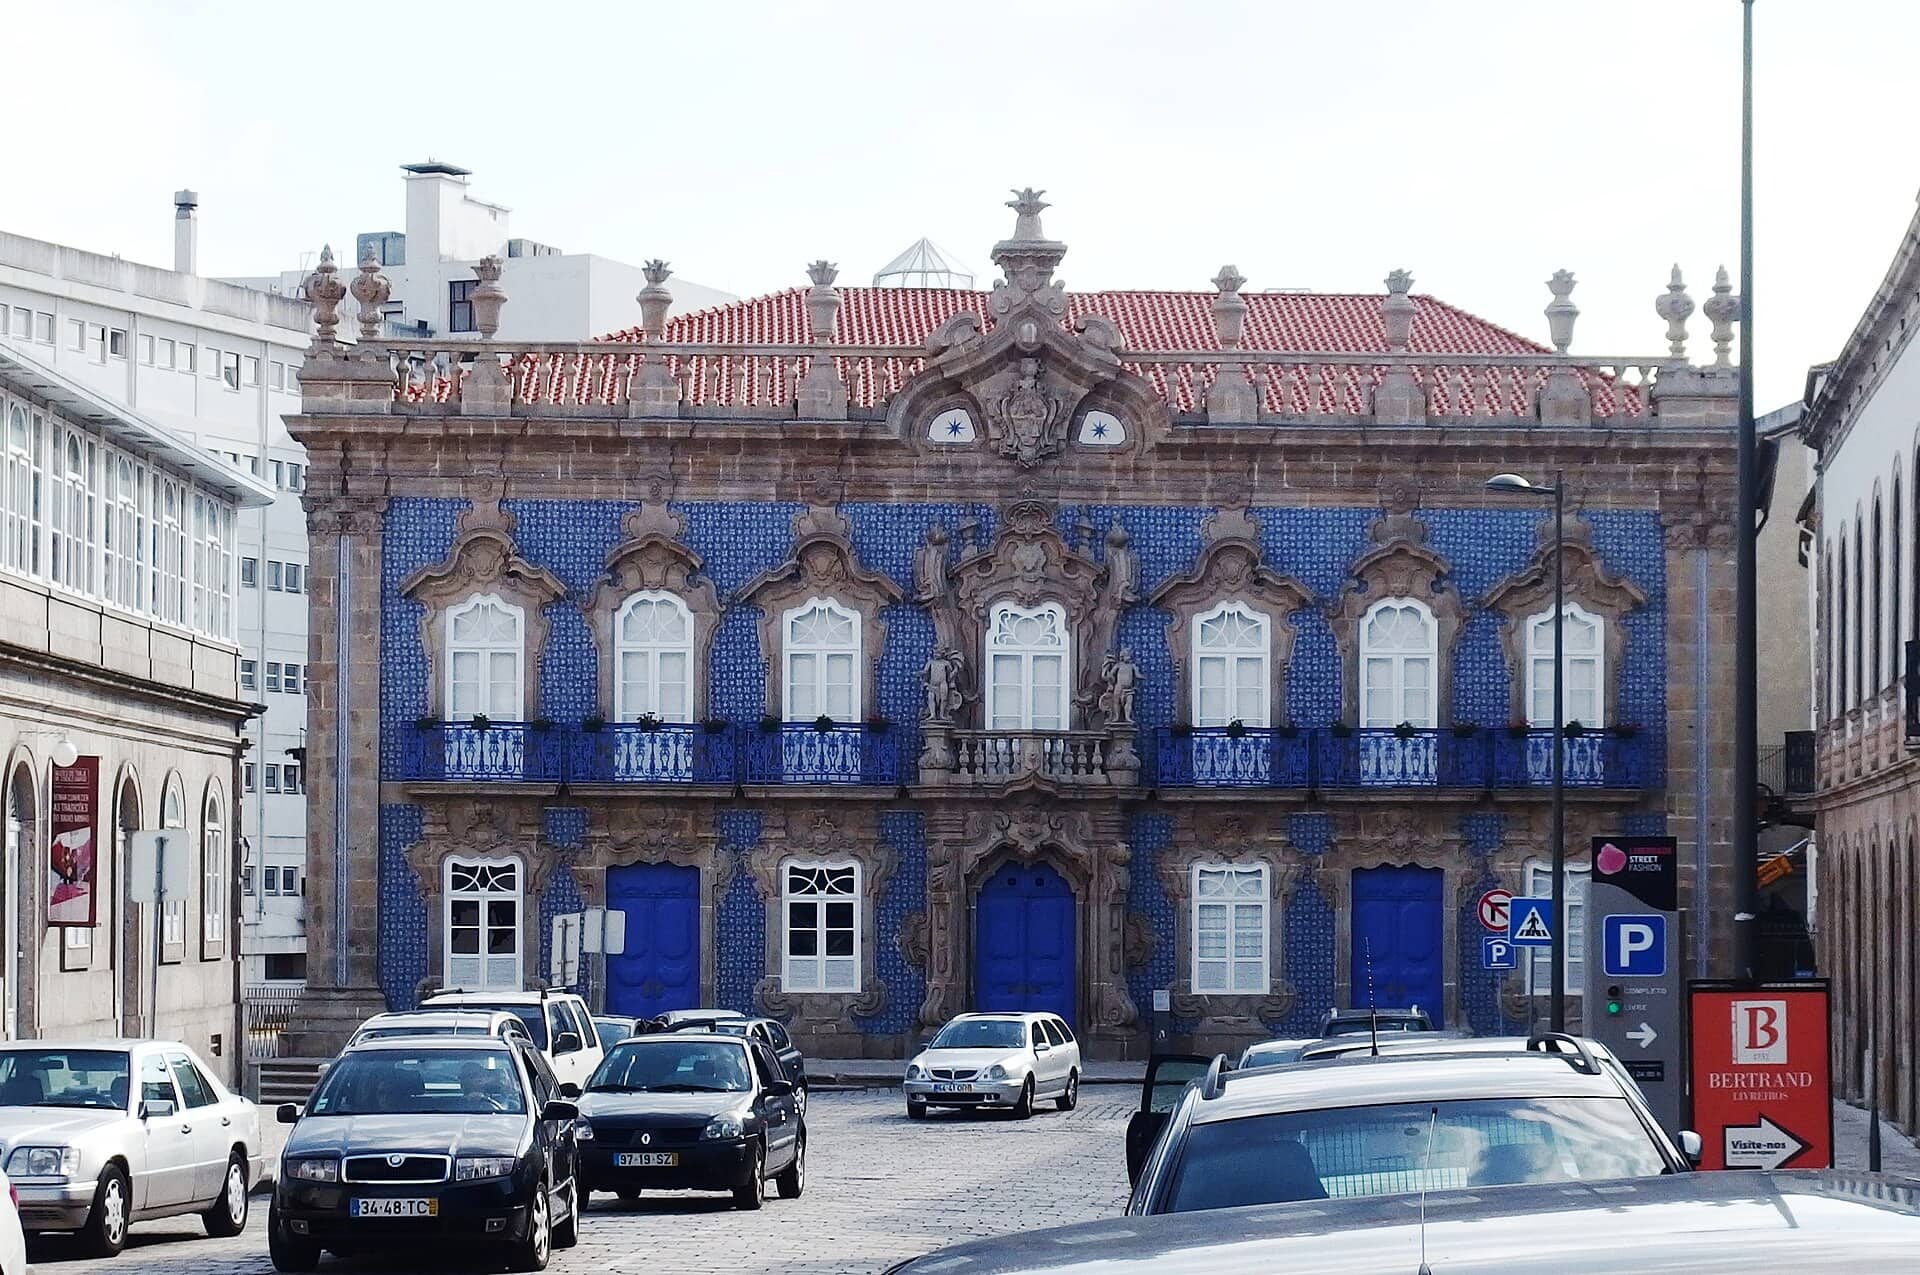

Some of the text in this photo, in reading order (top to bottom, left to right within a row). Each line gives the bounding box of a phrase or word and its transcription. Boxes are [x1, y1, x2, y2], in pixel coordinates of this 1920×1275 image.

[1629, 855, 1658, 863] STREET
[1629, 864, 1662, 872] FASHION
[1619, 923, 1655, 968] P
[1491, 944, 1507, 963] P
[1624, 987, 1668, 995] COMPLETO
[1744, 1006, 1779, 1050] B
[1709, 1072, 1813, 1089] BERTRAND
[1732, 1091, 1789, 1101] LIVREIROS
[1731, 1140, 1786, 1150] Visite-nos
